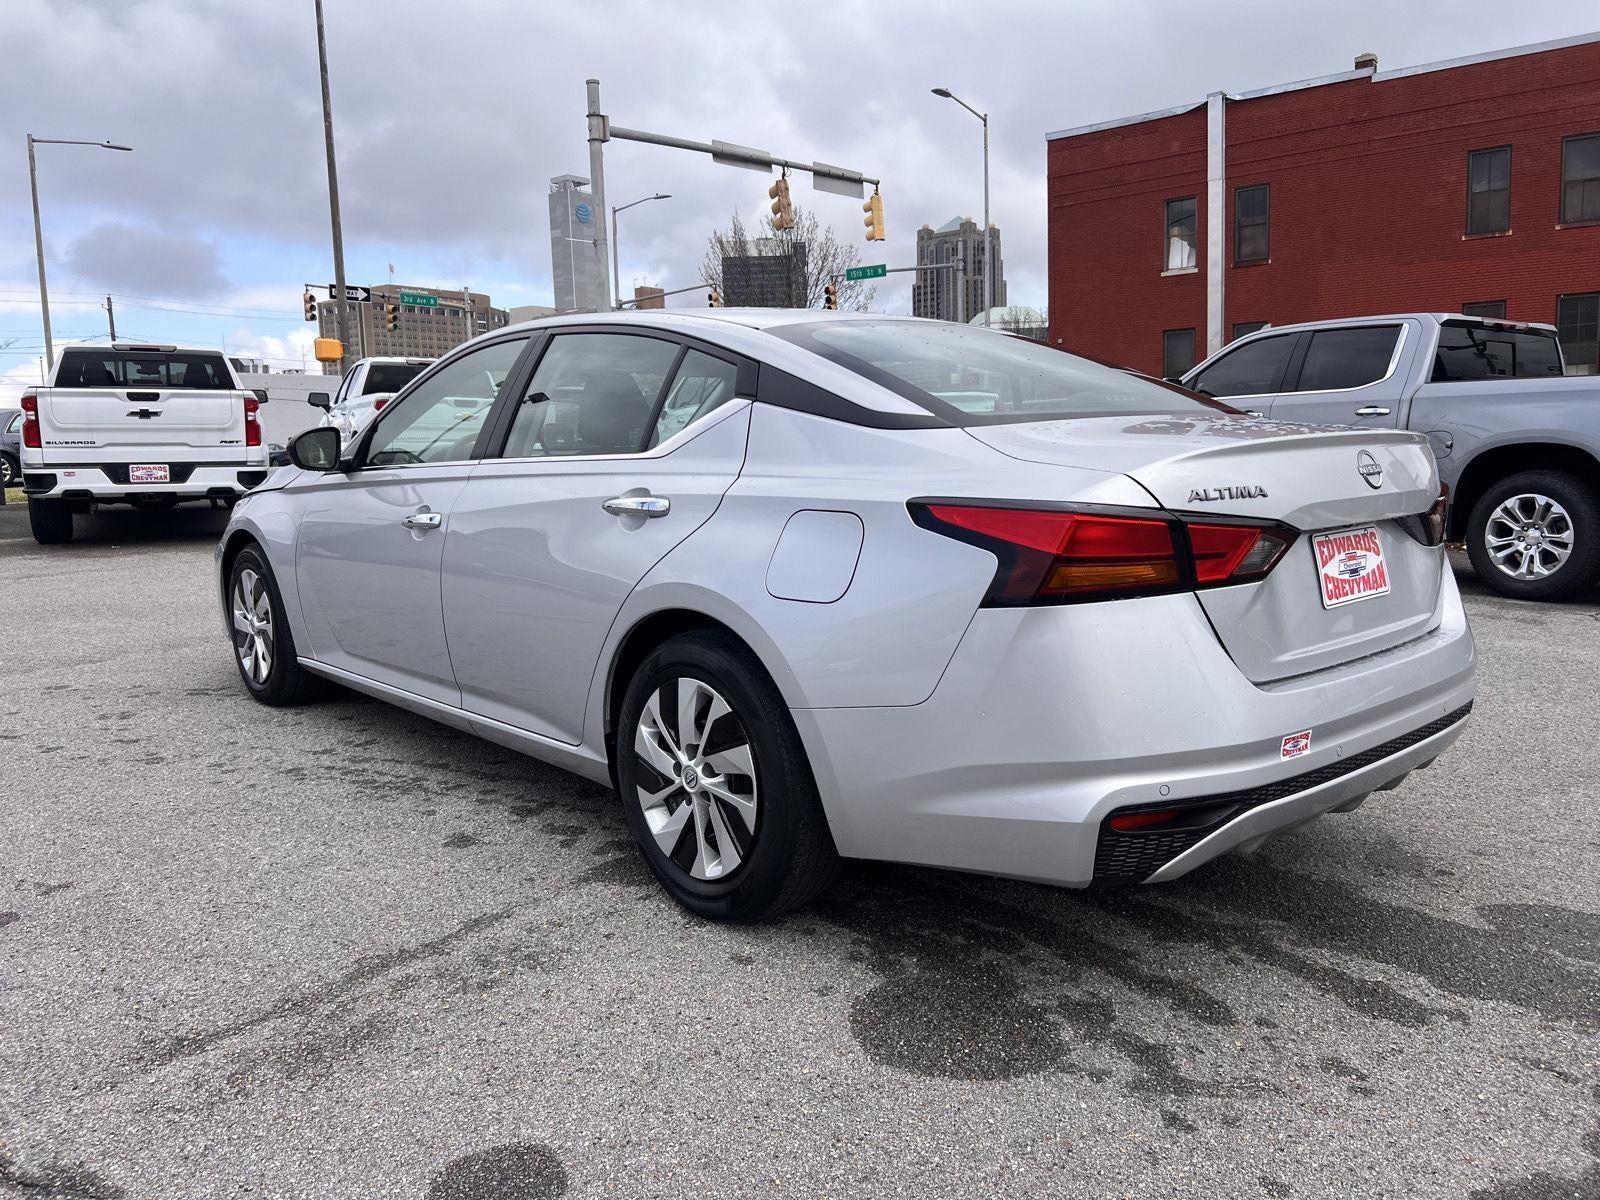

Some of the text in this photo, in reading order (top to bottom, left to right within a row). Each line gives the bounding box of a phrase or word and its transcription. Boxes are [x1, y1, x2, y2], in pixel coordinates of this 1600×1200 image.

[850, 270, 863, 278] 15th
[866, 268, 873, 276] St
[403, 295, 413, 303] 3rd
[416, 297, 427, 305] Ave
[131, 465, 168, 474] EDWARDS
[1359, 464, 1382, 474] NISSA
[131, 473, 168, 481] CHEVYMAN
[1188, 485, 1268, 502] ALTIMA
[1316, 532, 1381, 569] EDWARDS
[1323, 560, 1387, 601] CHEVYMAN
